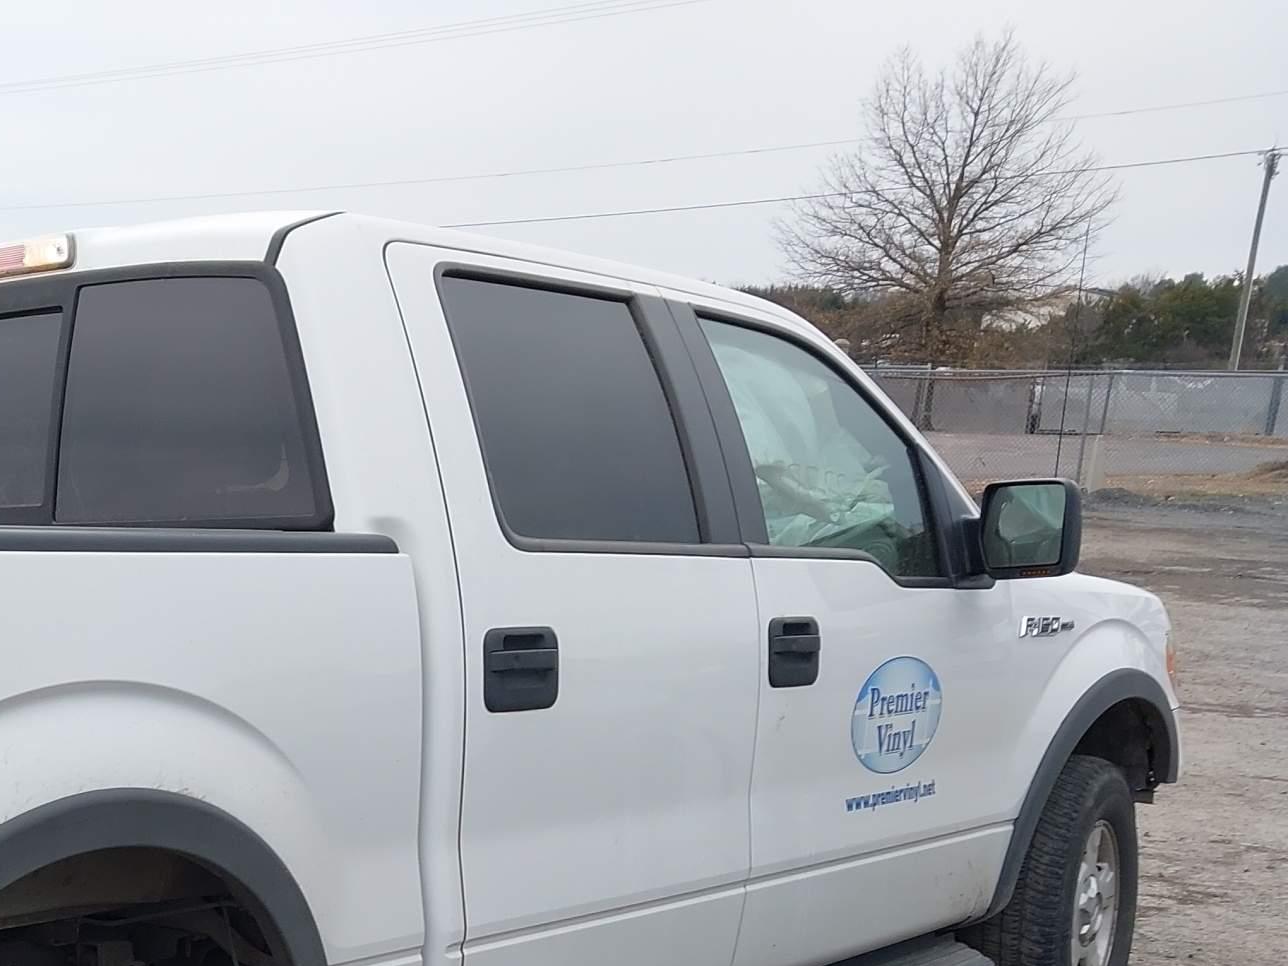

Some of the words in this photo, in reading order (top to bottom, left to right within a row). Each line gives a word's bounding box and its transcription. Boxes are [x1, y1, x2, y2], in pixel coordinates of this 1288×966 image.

[867, 683, 930, 718] Premier
[876, 720, 916, 759] Vinyl
[844, 779, 936, 812] www.premiervinyl.net
